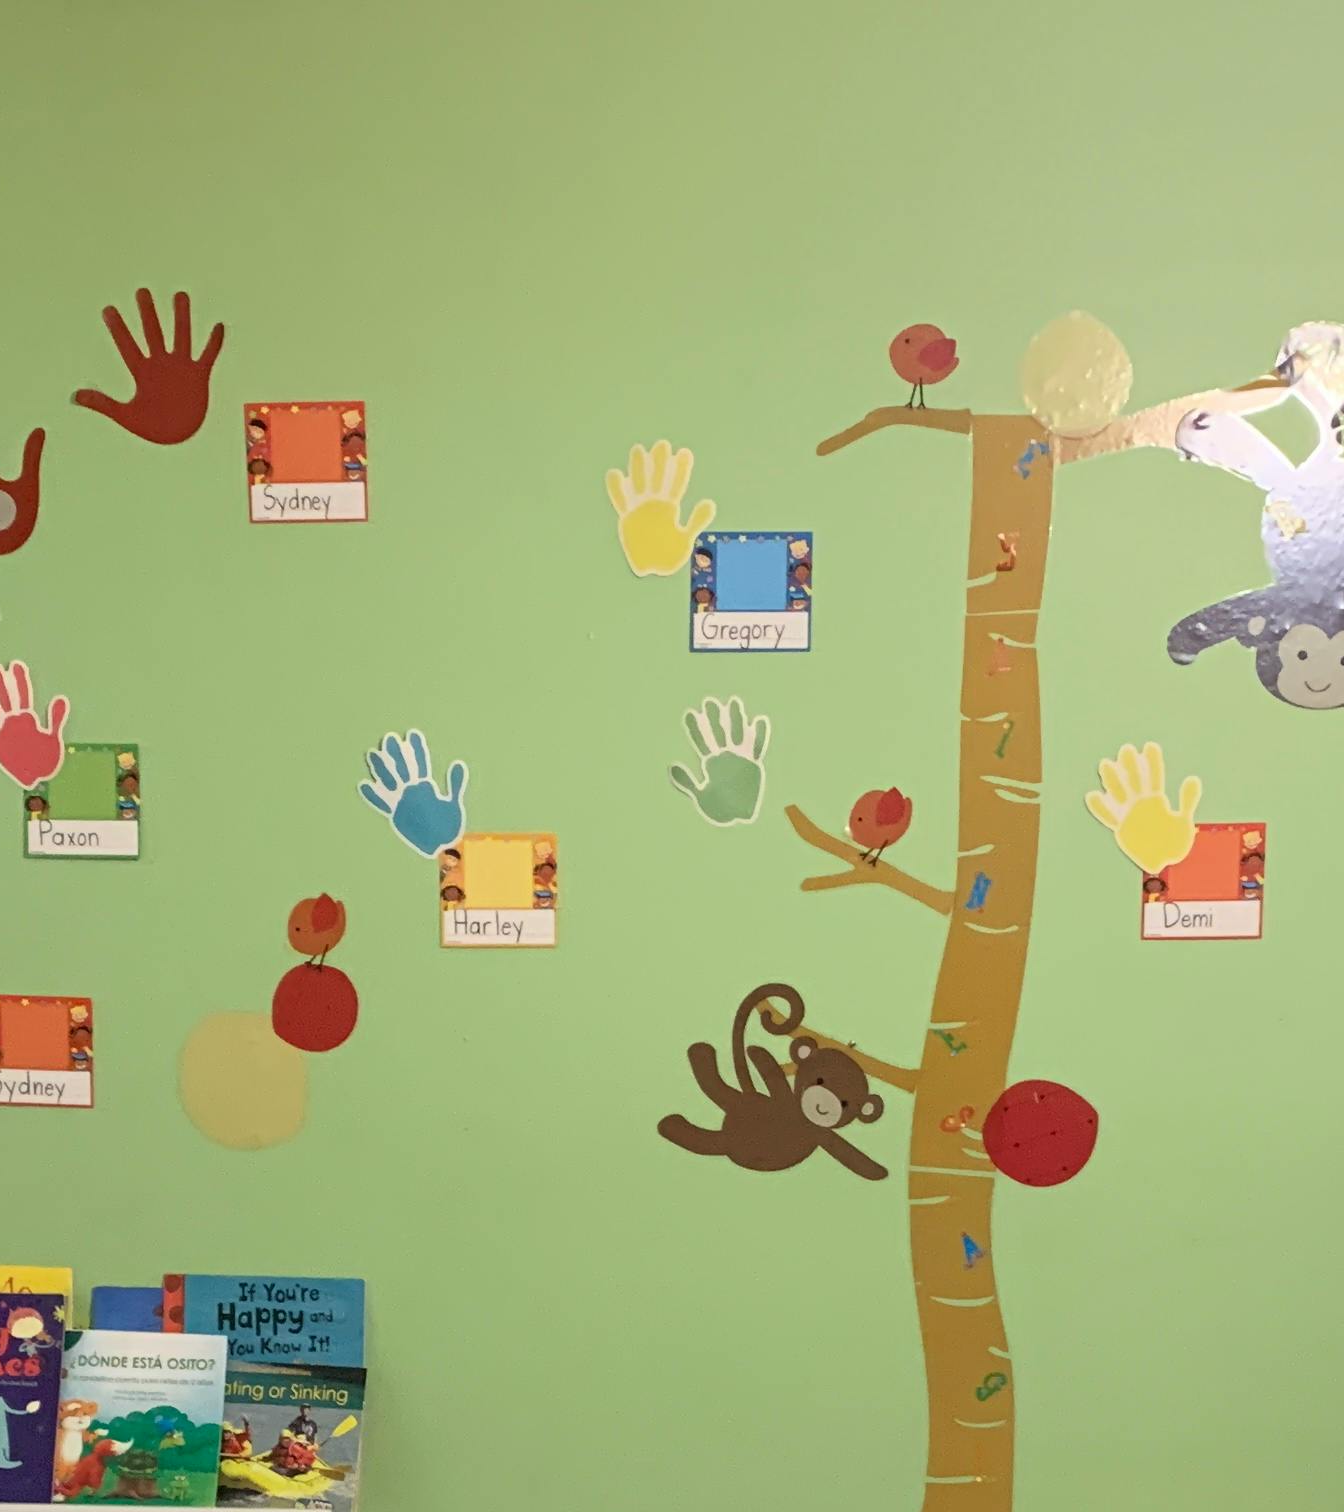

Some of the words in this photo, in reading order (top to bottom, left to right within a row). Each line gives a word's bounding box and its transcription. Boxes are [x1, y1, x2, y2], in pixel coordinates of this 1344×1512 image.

[263, 484, 332, 520] Sydney
[701, 612, 786, 650] Gregory
[38, 819, 100, 847] Paxon
[453, 908, 524, 943] Harley
[1162, 901, 1214, 929] Demi
[238, 1281, 257, 1302] If
[262, 1281, 321, 1304] You're
[216, 1301, 305, 1338] Happy
[309, 1309, 334, 1323] and
[227, 1337, 256, 1357] You
[259, 1336, 302, 1355] Know
[307, 1334, 331, 1353] It!
[166, 1356, 217, 1371] OSITO?
[223, 1380, 264, 1402] ating
[268, 1386, 287, 1400] or
[288, 1382, 350, 1406] Sinking
